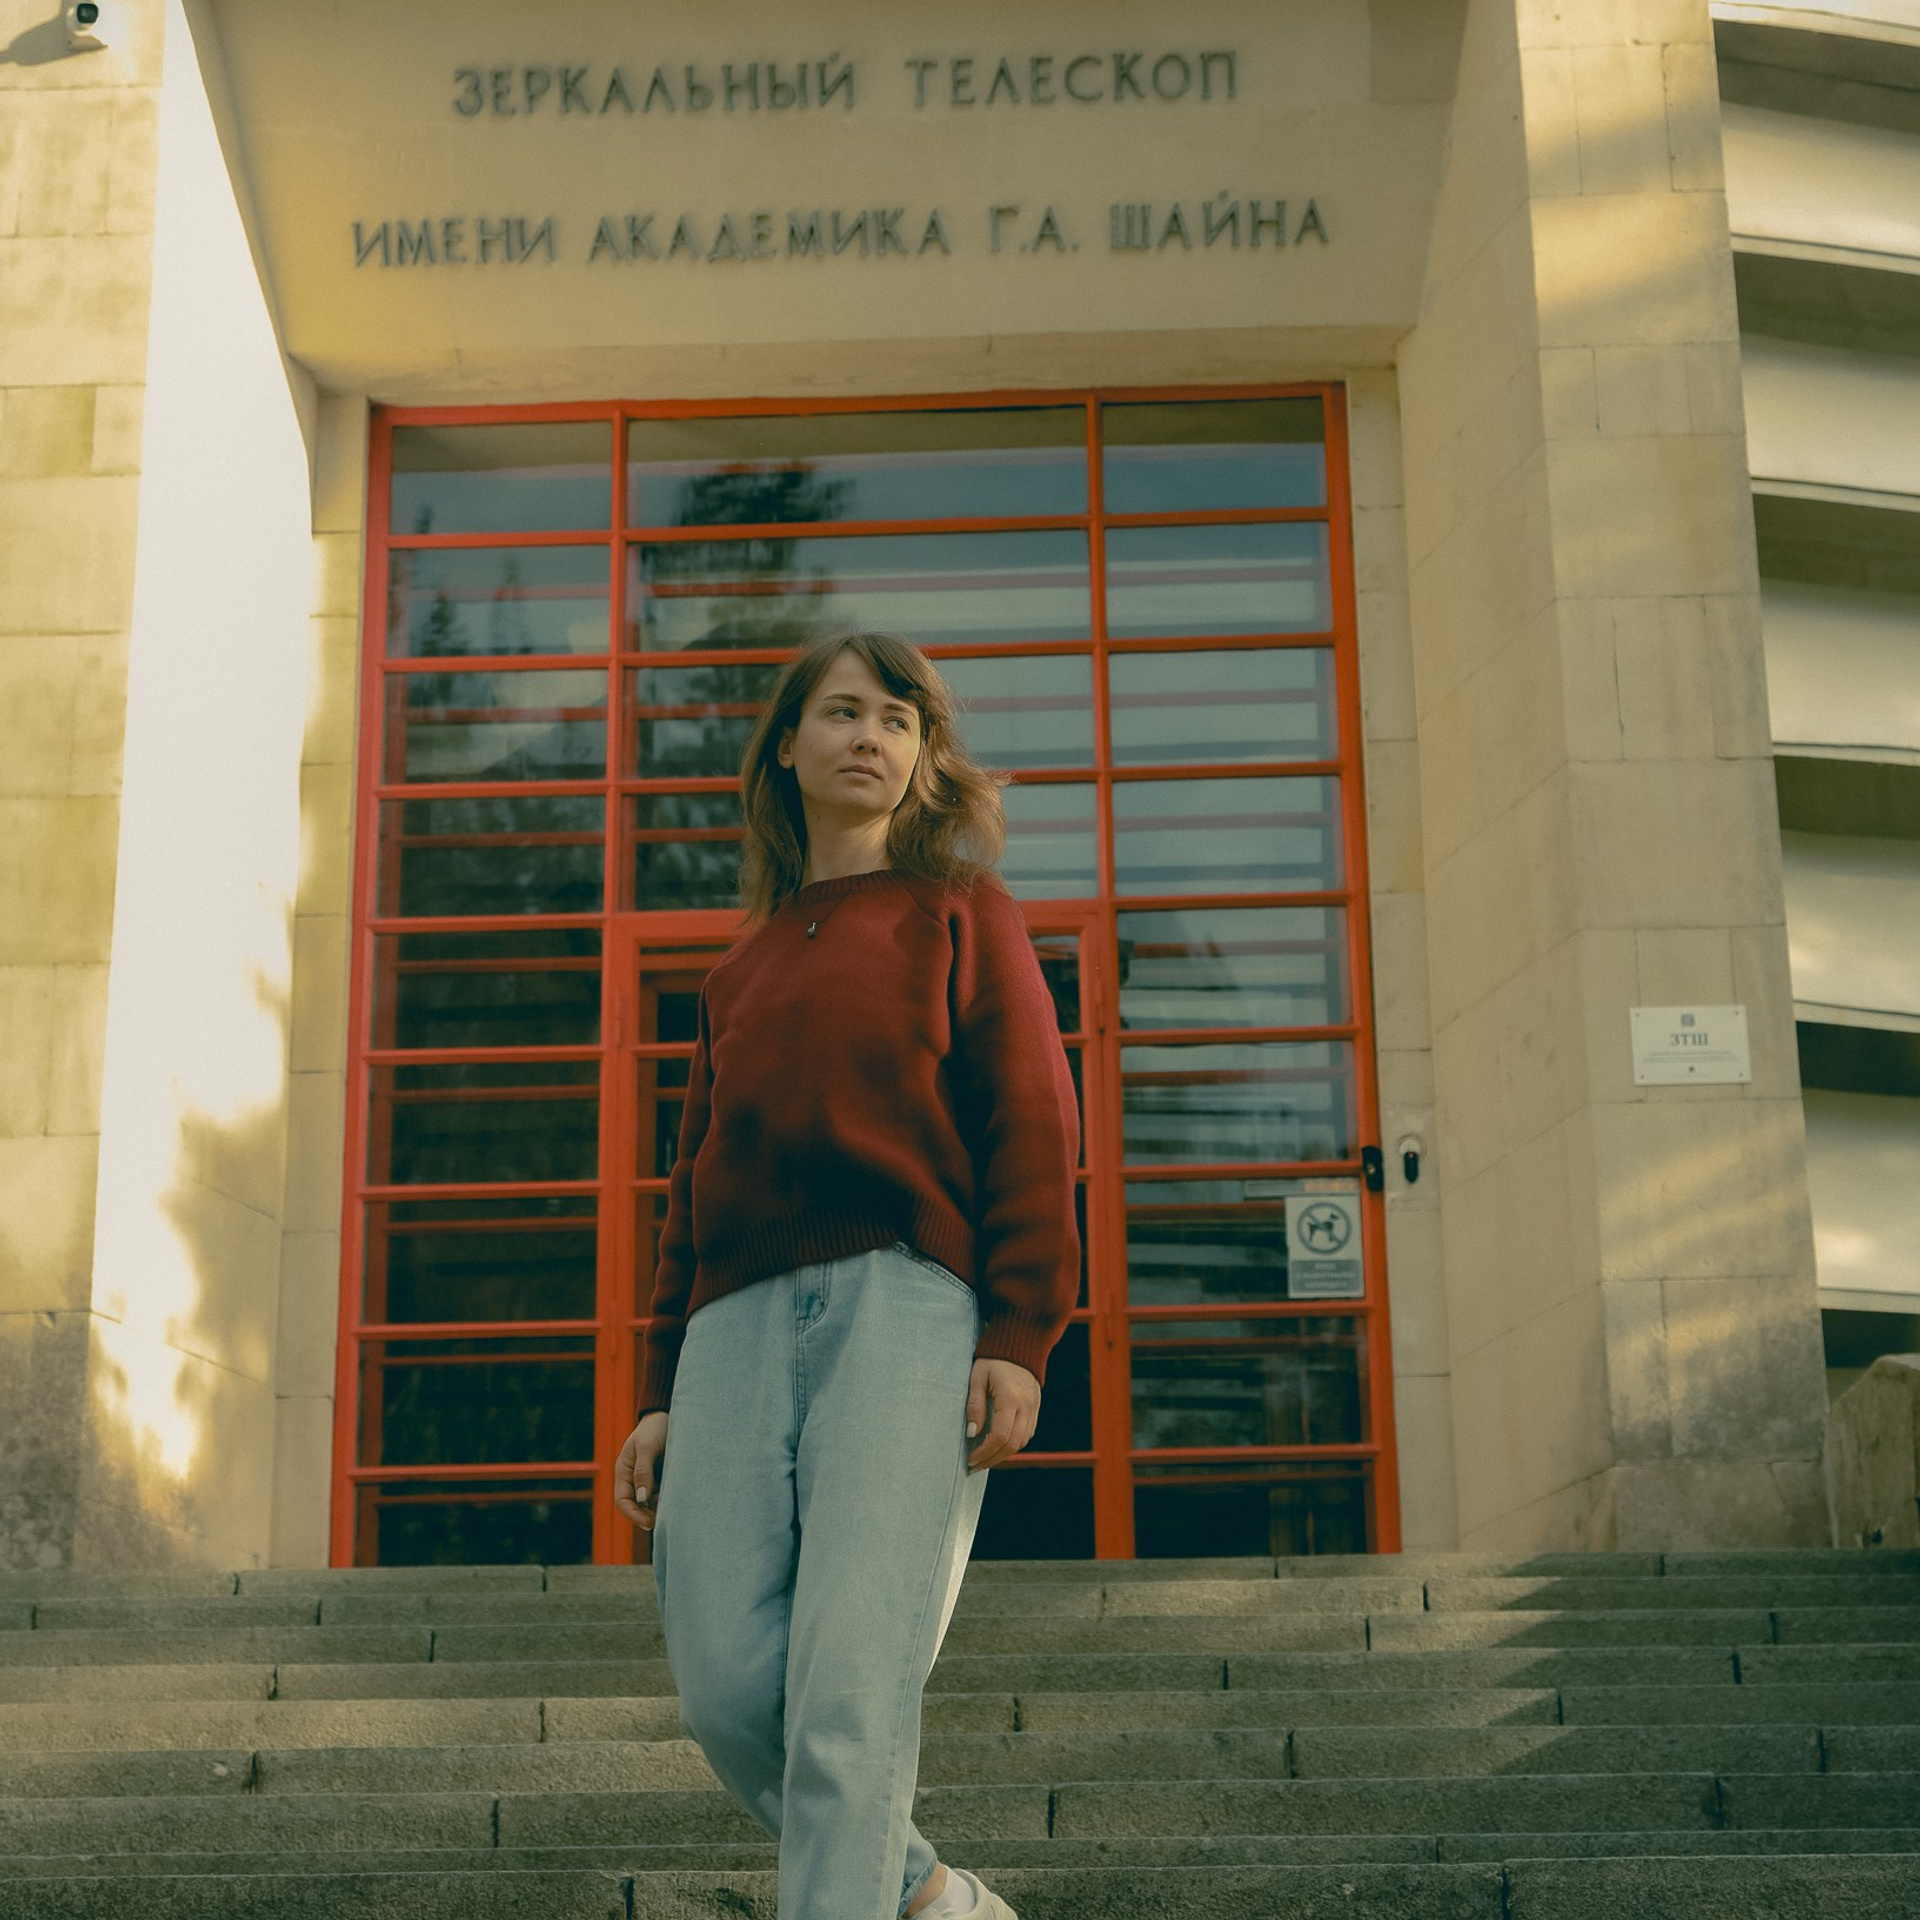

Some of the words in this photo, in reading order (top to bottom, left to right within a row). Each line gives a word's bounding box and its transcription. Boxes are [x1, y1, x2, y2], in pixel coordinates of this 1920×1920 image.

[452, 51, 855, 117] ЗЕРКАЛЬНЫЙ
[904, 50, 1237, 107] ТЕЛЕСКОП
[352, 214, 556, 268] ИМЕНИ
[586, 206, 951, 263] АКАДЕМИКА
[990, 205, 1080, 254] Г.А.
[1110, 189, 1330, 252] ШАЙНА
[1670, 1033, 1709, 1046] ЗТШ
